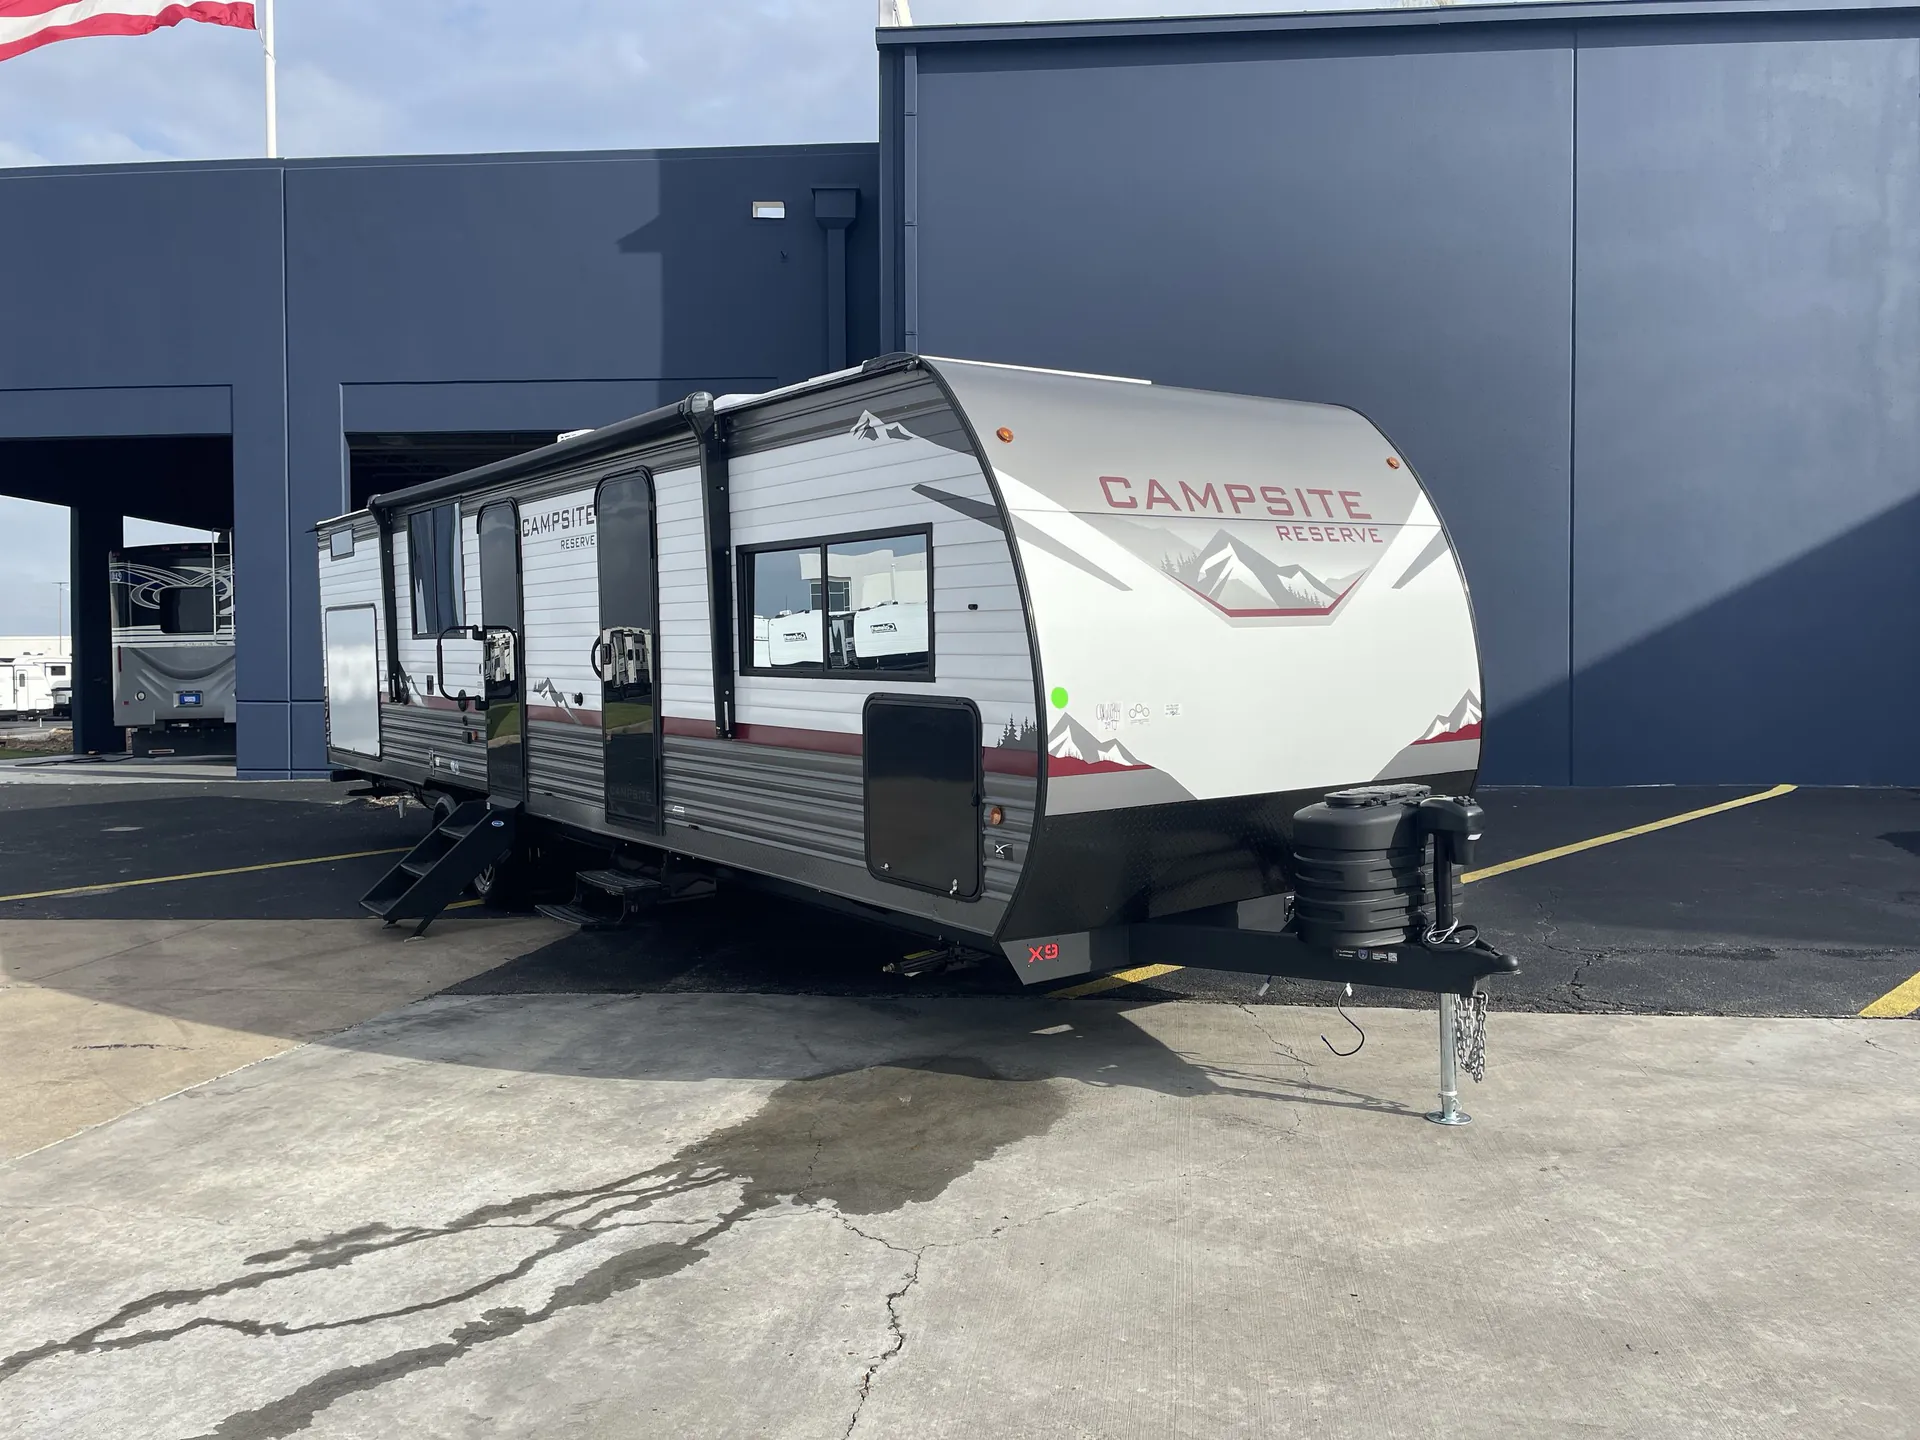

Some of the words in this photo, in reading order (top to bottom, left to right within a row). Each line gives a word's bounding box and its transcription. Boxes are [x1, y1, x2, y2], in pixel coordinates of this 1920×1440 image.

[1099, 476, 1372, 519] CAMPSITE
[522, 504, 595, 537] CAMPSITE
[561, 535, 595, 550] RESERVE
[1276, 525, 1383, 543] RESERVE
[1028, 943, 1059, 963] X9
